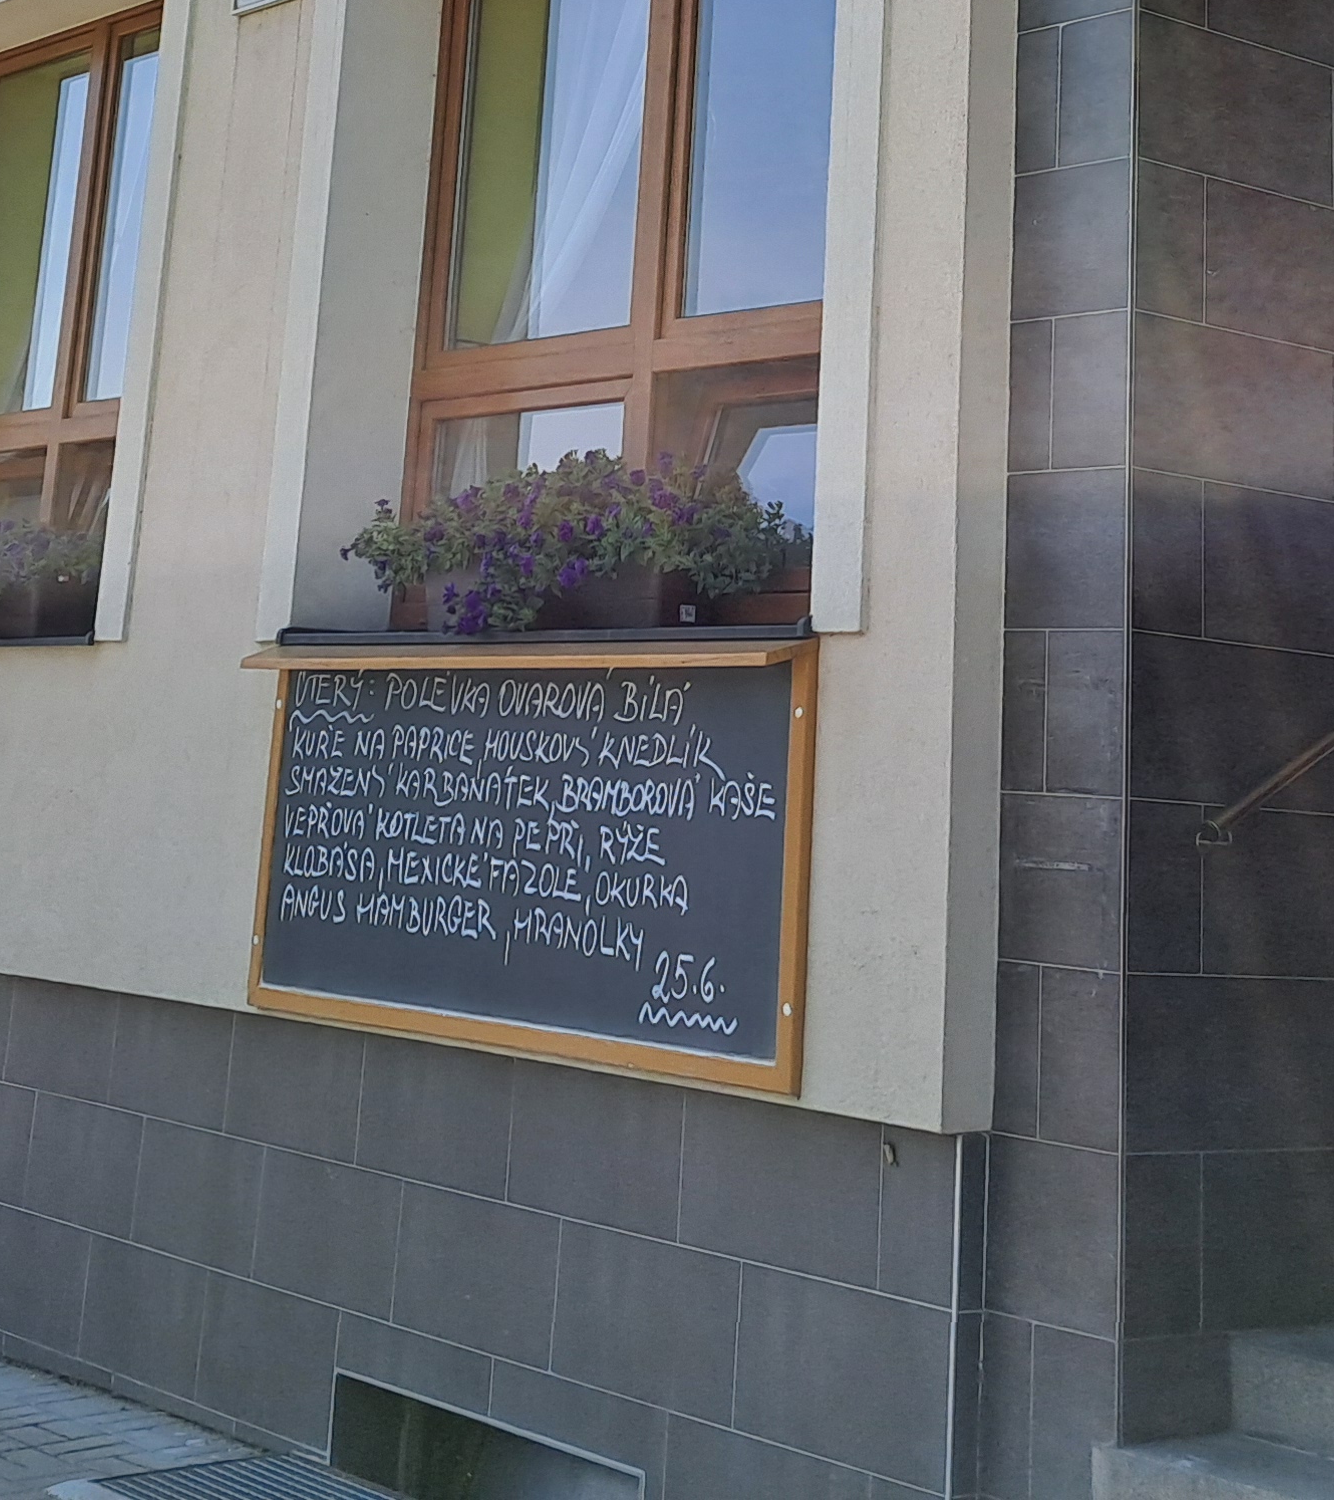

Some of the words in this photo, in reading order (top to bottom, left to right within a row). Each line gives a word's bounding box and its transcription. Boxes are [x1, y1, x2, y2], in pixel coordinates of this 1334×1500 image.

[384, 670, 491, 718] POLÉVKA
[354, 728, 385, 760] NA
[598, 724, 727, 781] KNEDLÍK
[708, 771, 776, 821] KAŠE
[375, 807, 466, 846] KOTLETA
[470, 815, 504, 849] NA
[279, 882, 346, 924] ANGUS
[387, 847, 489, 889] MEXICKÉ
[595, 870, 689, 916] OKURKA
[651, 950, 725, 1003] 25.6.
